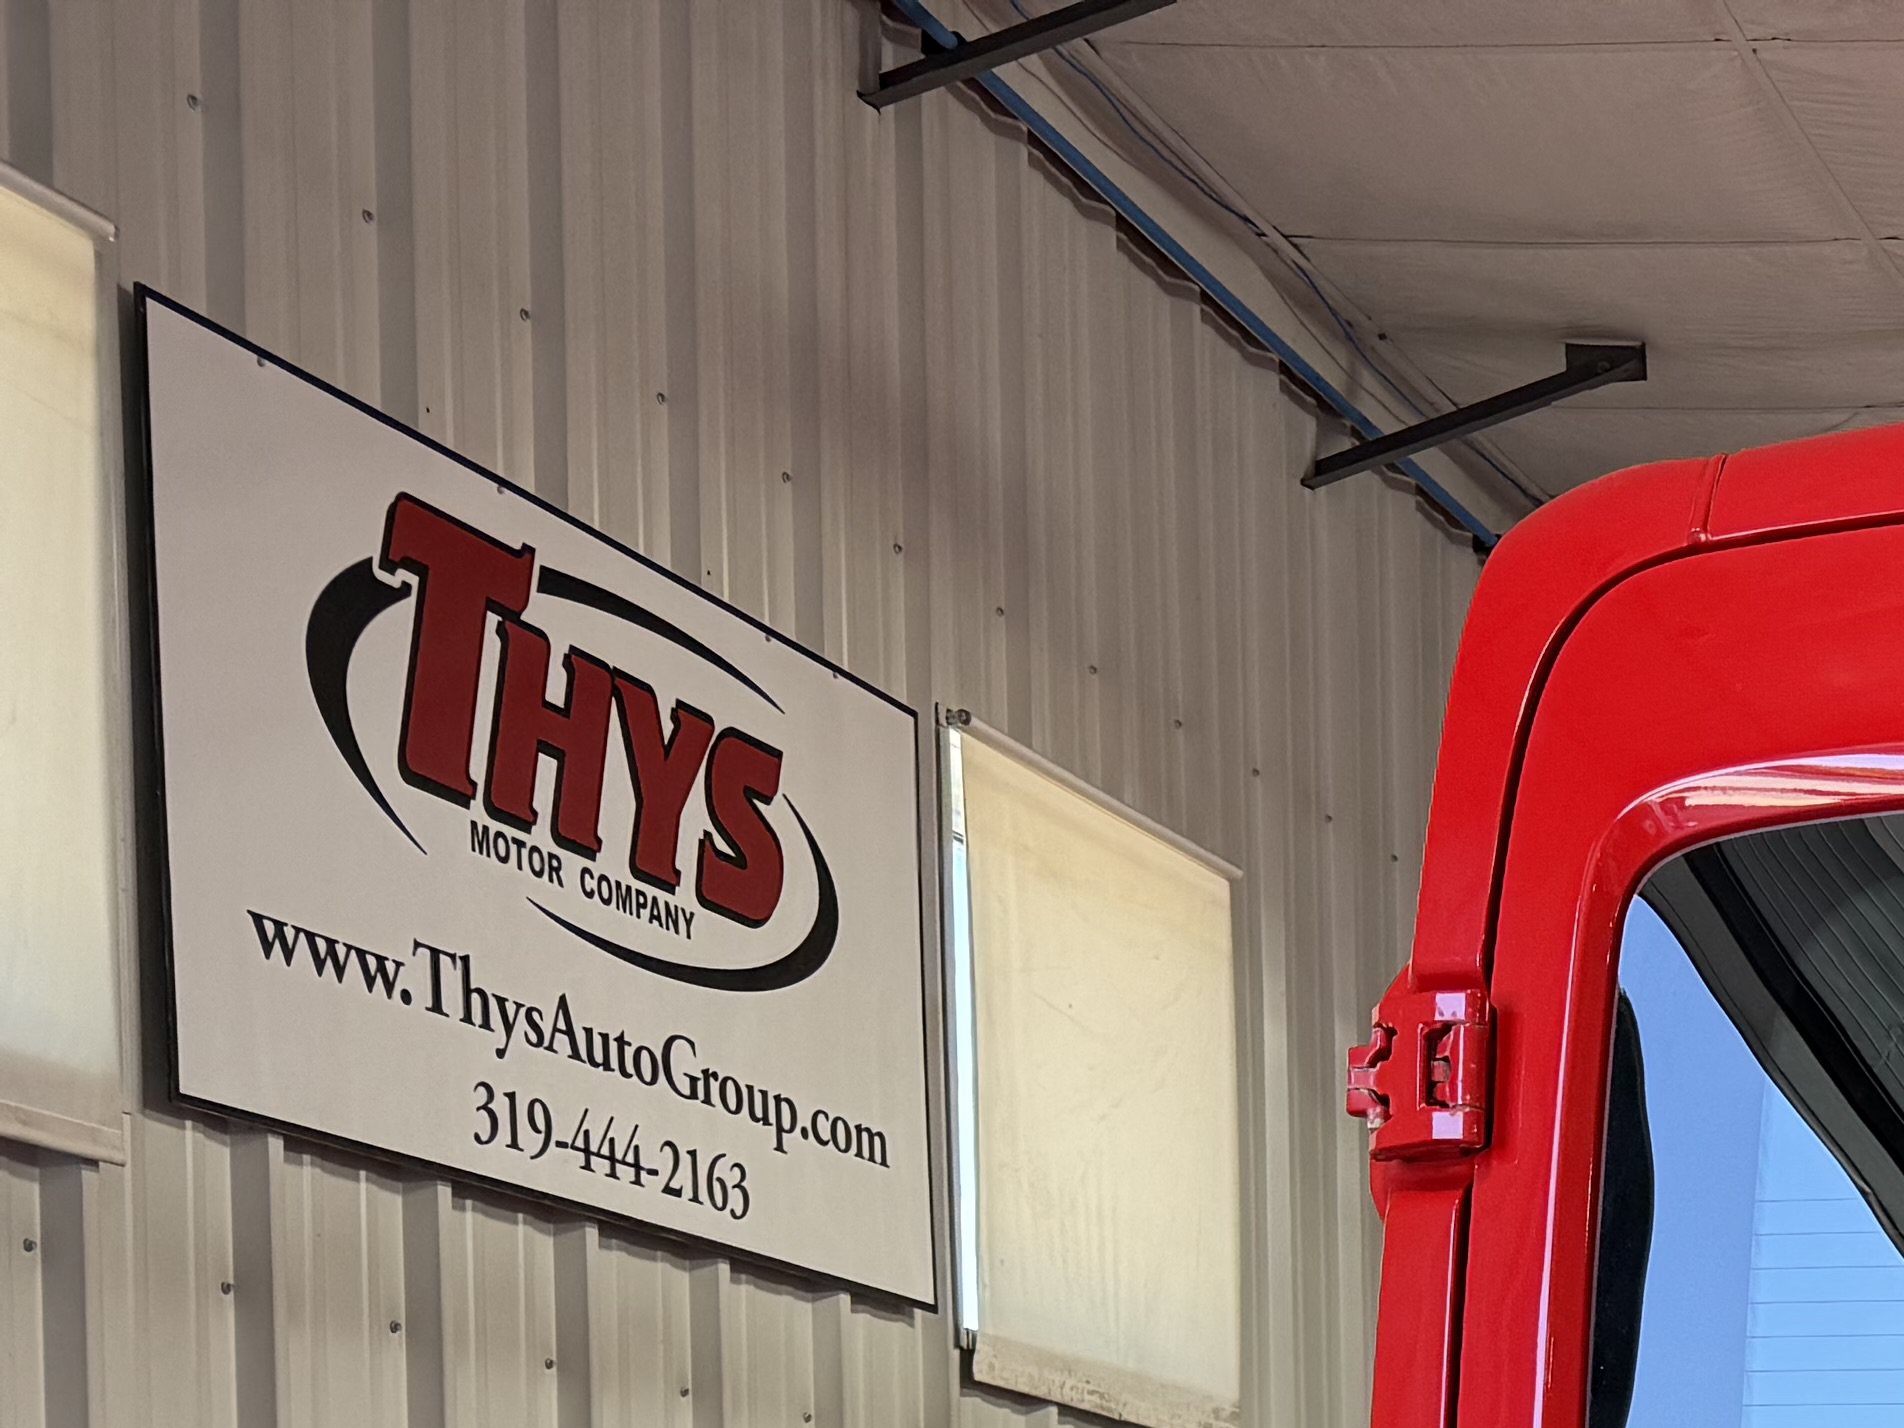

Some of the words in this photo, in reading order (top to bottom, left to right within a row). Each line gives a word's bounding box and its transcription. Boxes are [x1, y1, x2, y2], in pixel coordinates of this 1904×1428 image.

[382, 492, 785, 928] THYS
[468, 819, 565, 889] MOTOR
[579, 866, 696, 941] COMPANY
[246, 909, 889, 1168] www.ThysAutoGroup.com
[472, 1081, 751, 1221] 319-444-2163
